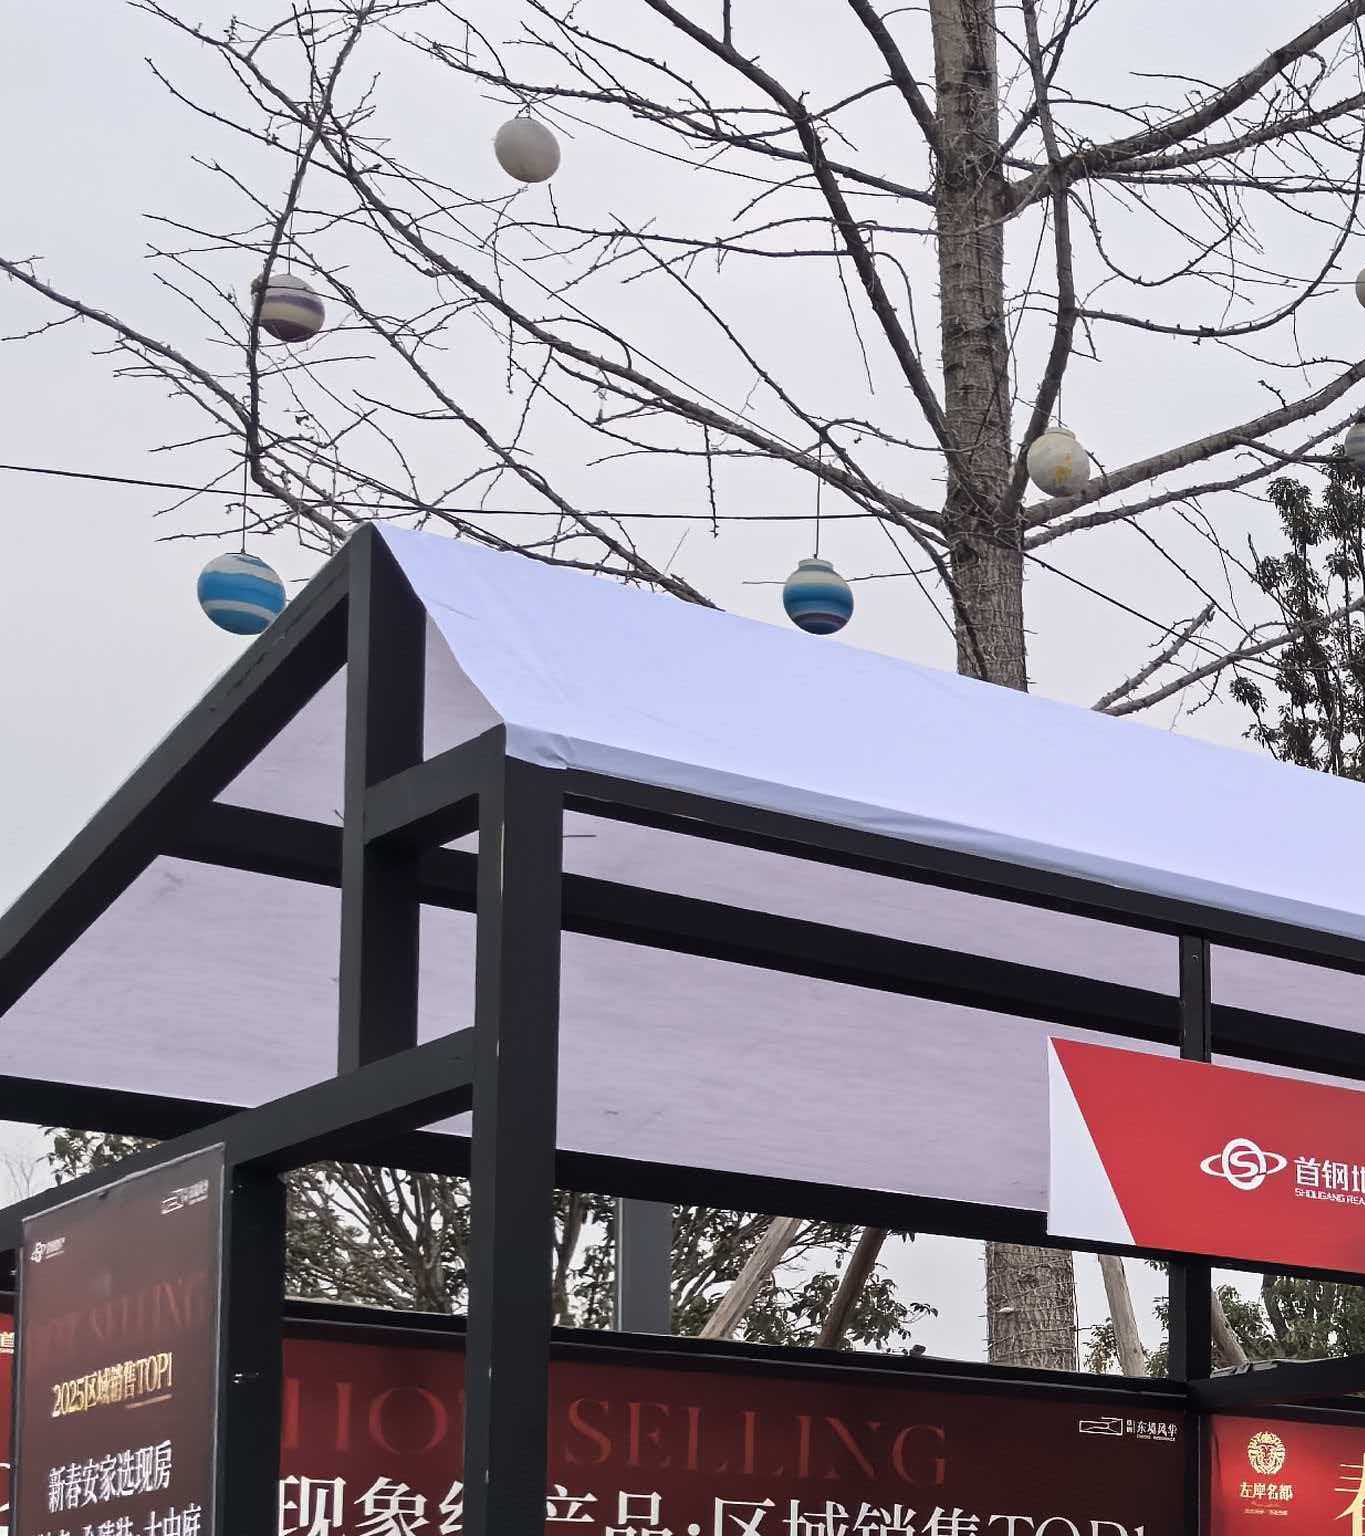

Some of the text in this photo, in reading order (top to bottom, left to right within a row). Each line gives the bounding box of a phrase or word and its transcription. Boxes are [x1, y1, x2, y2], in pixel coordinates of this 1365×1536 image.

[51, 1352, 172, 1417] 2025区域销售TOP1
[280, 1378, 947, 1487] HO SELLING
[48, 1440, 172, 1513] 新春安家选现房
[1239, 1481, 1293, 1501] 左岸名都
